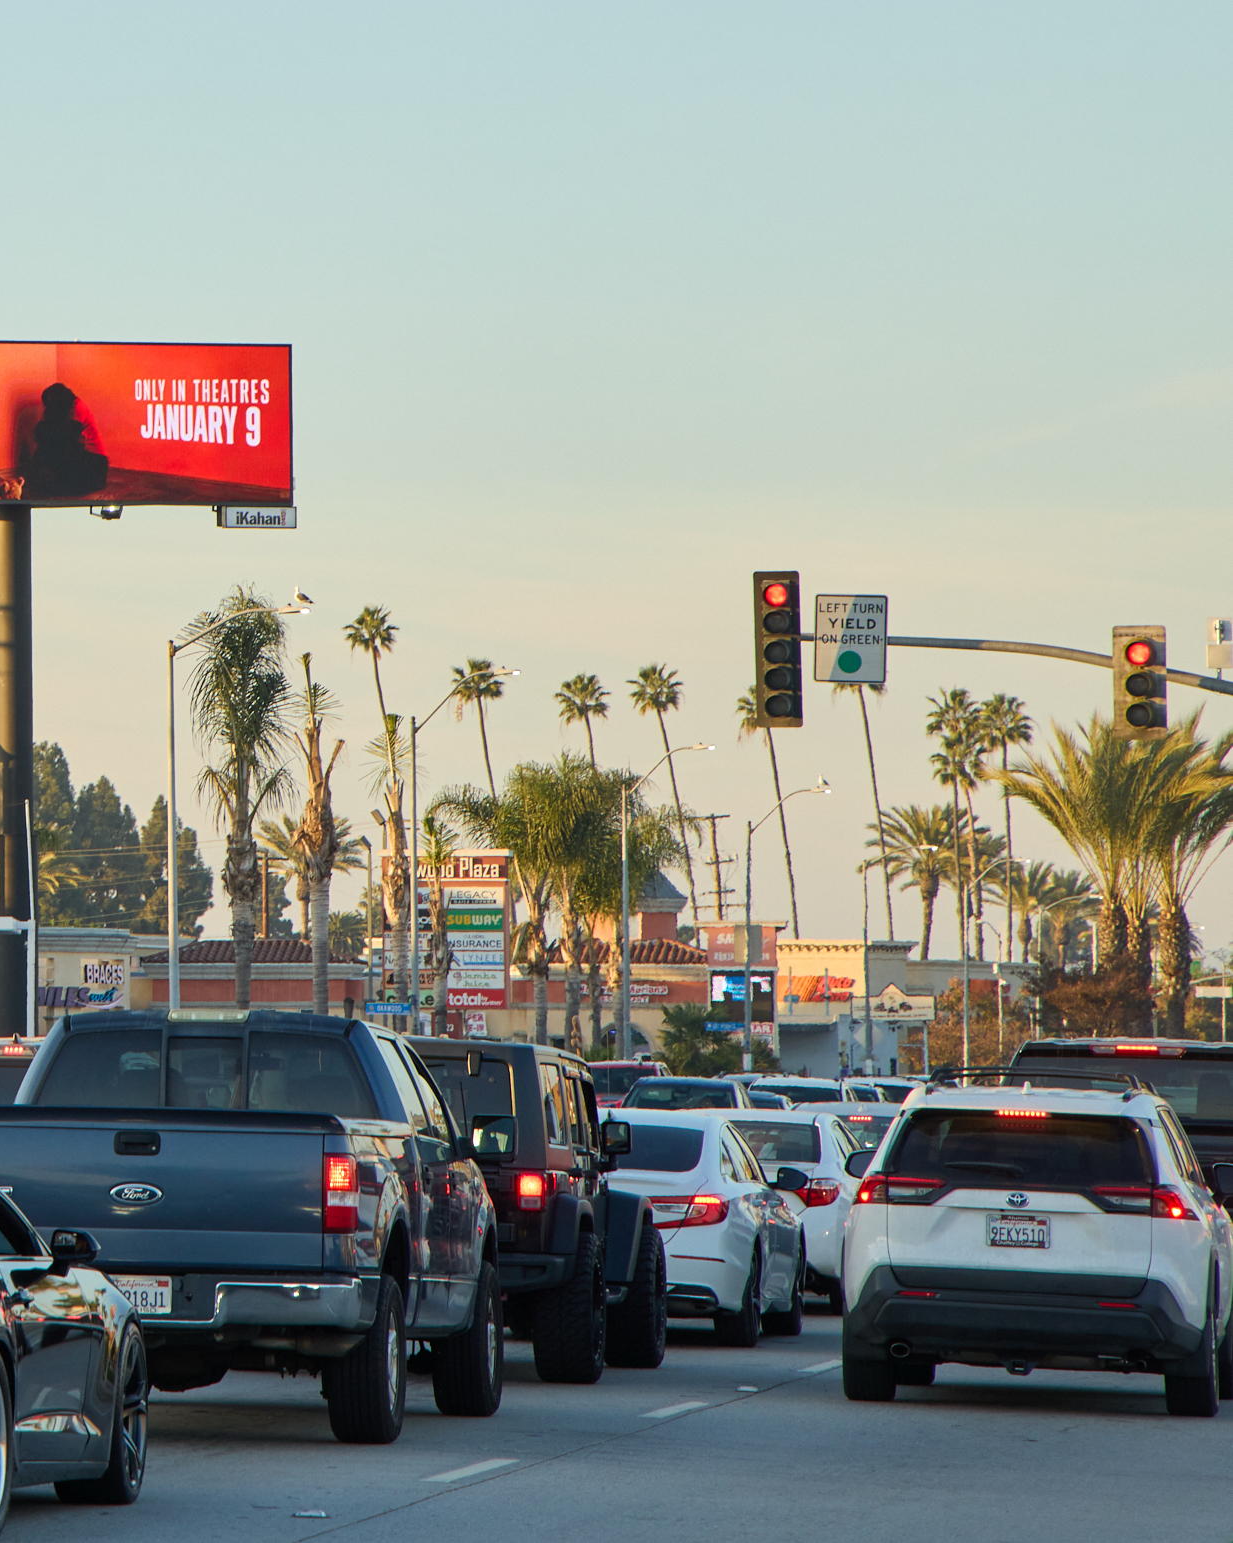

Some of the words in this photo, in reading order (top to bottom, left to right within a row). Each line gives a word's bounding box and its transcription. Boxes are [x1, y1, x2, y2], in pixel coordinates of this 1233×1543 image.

[134, 379, 165, 401] ONLY
[172, 379, 186, 402] IN
[193, 379, 270, 405] THEATRES
[140, 404, 238, 445] JANUARY
[245, 406, 261, 447] 9
[819, 603, 848, 613] LEFT
[852, 603, 883, 614] TURN
[828, 618, 876, 630] YIELD
[821, 634, 837, 644] ON
[841, 634, 880, 645] GREEN
[459, 857, 499, 878] Plaza
[451, 891, 497, 899] LEGACY
[446, 914, 503, 926] SUBWAY
[448, 940, 502, 948] NSURANCE
[86, 964, 124, 985] BRACES
[38, 986, 91, 1007] ILES
[448, 992, 481, 1006] total
[121, 1187, 150, 1200] Ford
[991, 1227, 1045, 1242] 9EKY510
[115, 1280, 156, 1290] California
